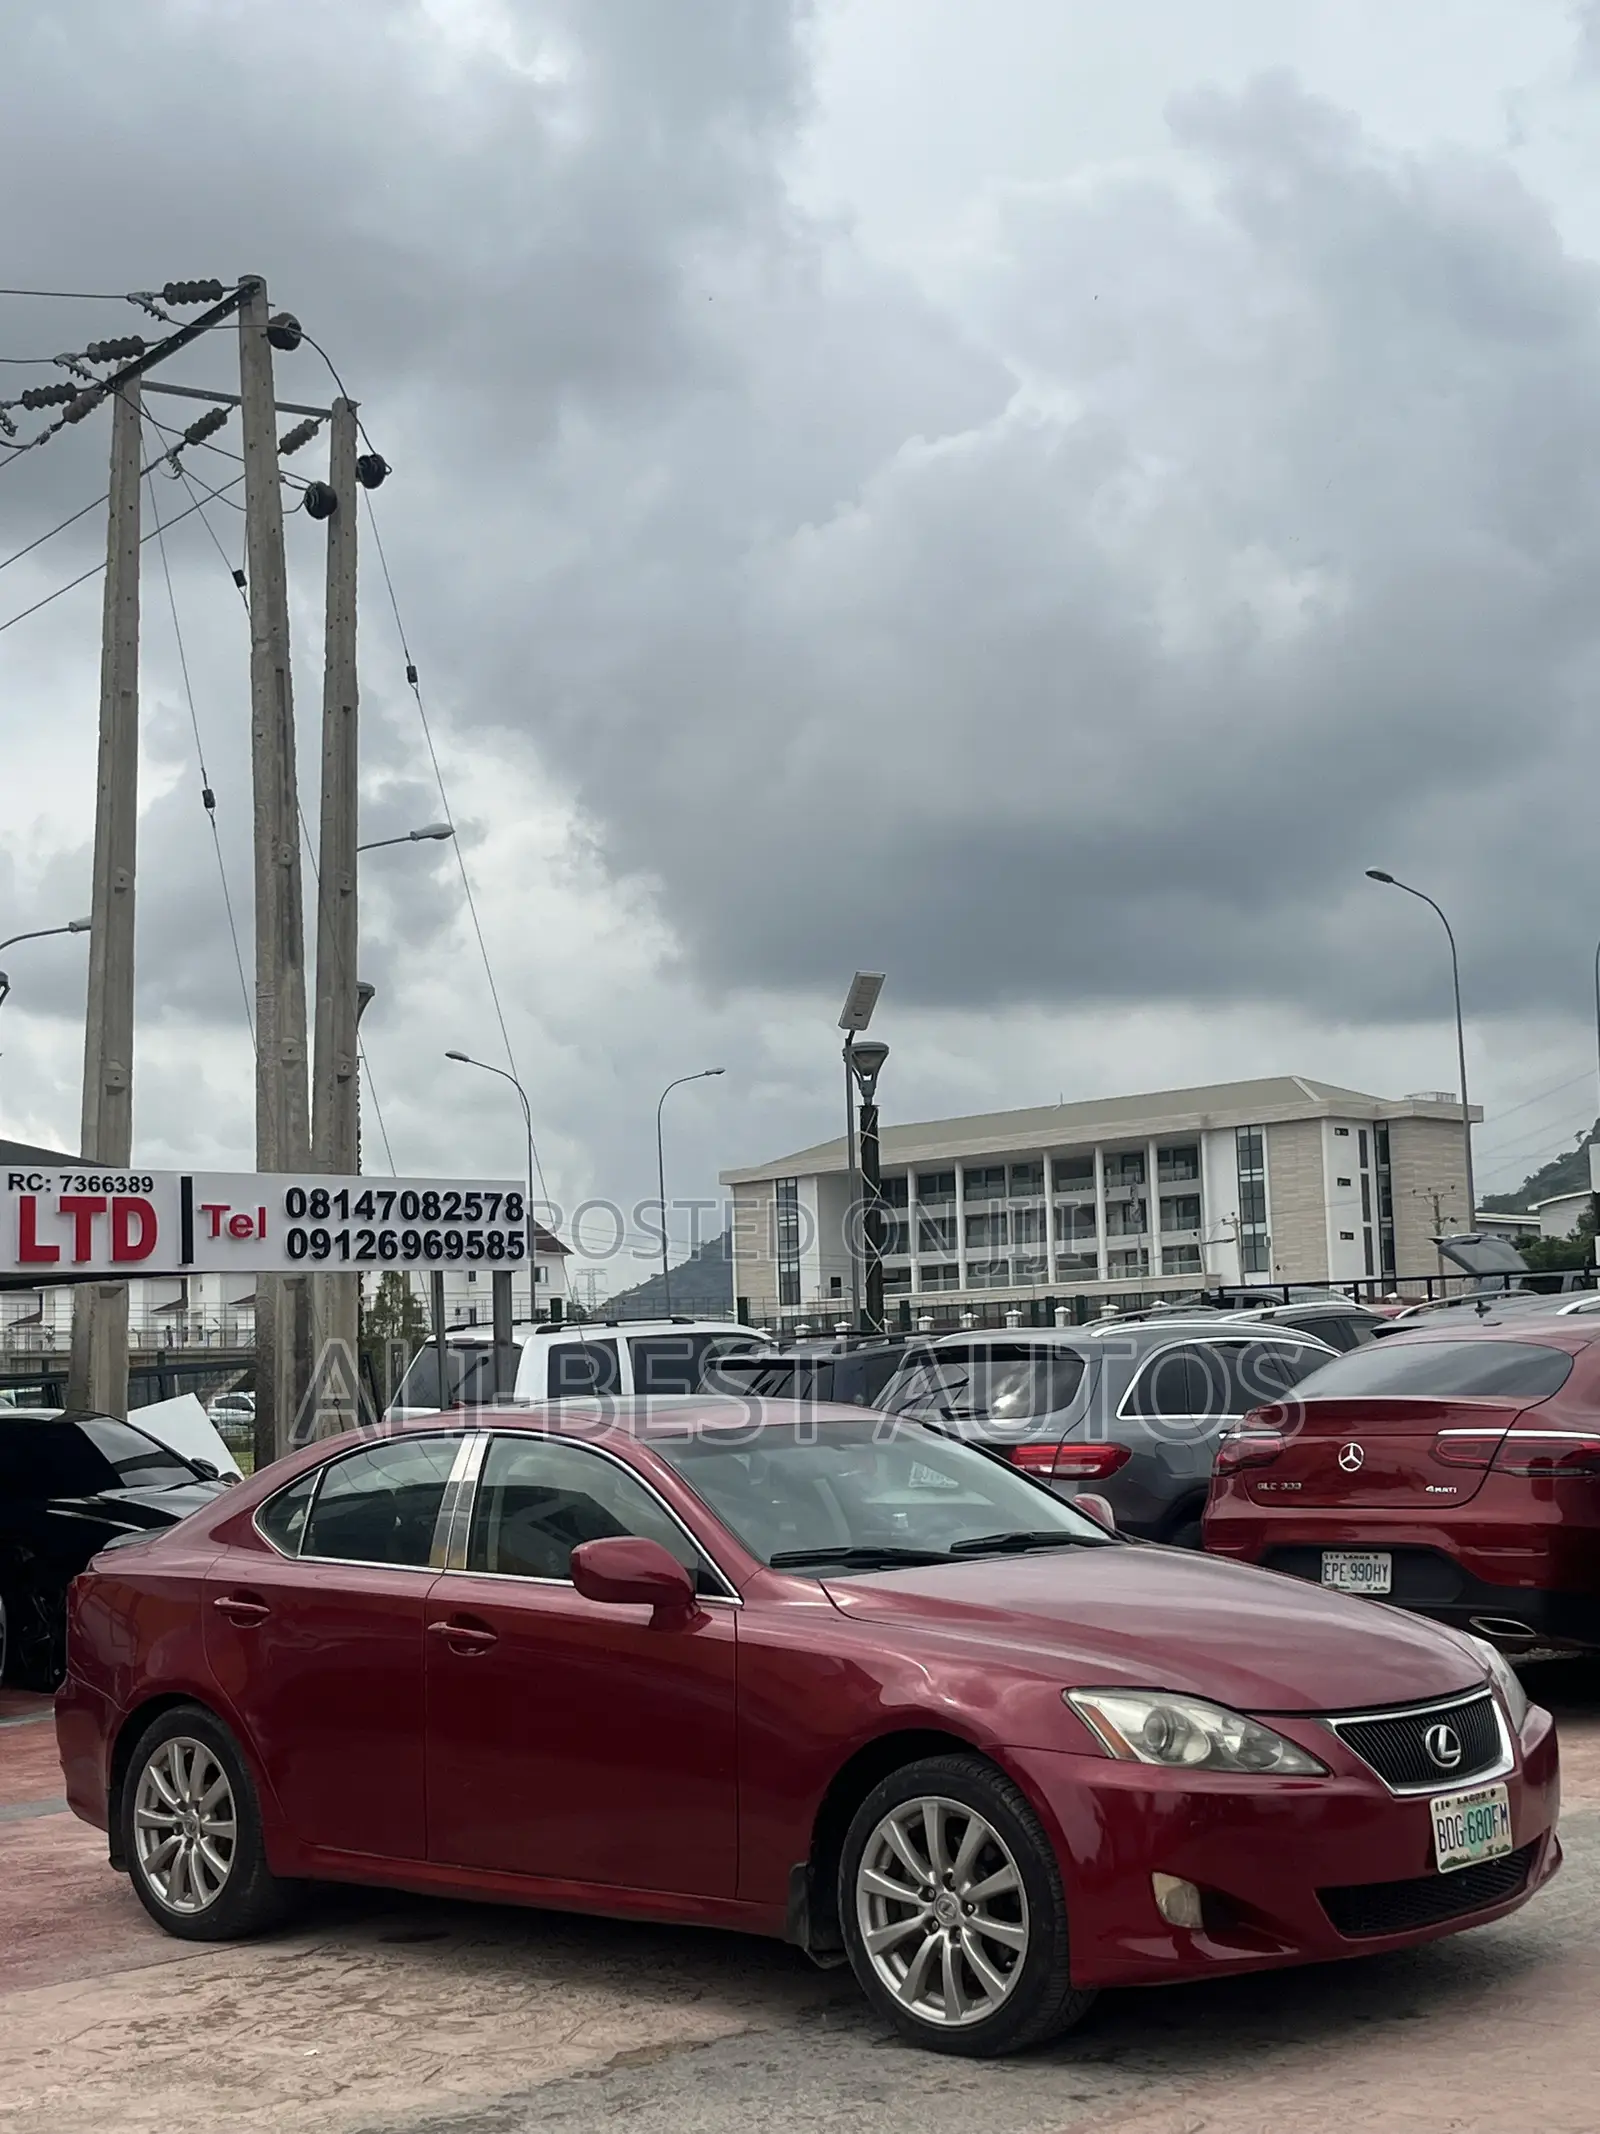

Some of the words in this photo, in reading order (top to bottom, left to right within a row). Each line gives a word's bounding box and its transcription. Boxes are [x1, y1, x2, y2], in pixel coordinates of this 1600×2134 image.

[8, 1173, 51, 1193] RC:
[59, 1174, 154, 1194] 7366389
[200, 1204, 267, 1239] Tel
[285, 1187, 524, 1223] 08147082578
[17, 1195, 159, 1263] LTD
[286, 1227, 525, 1261] 09126969585
